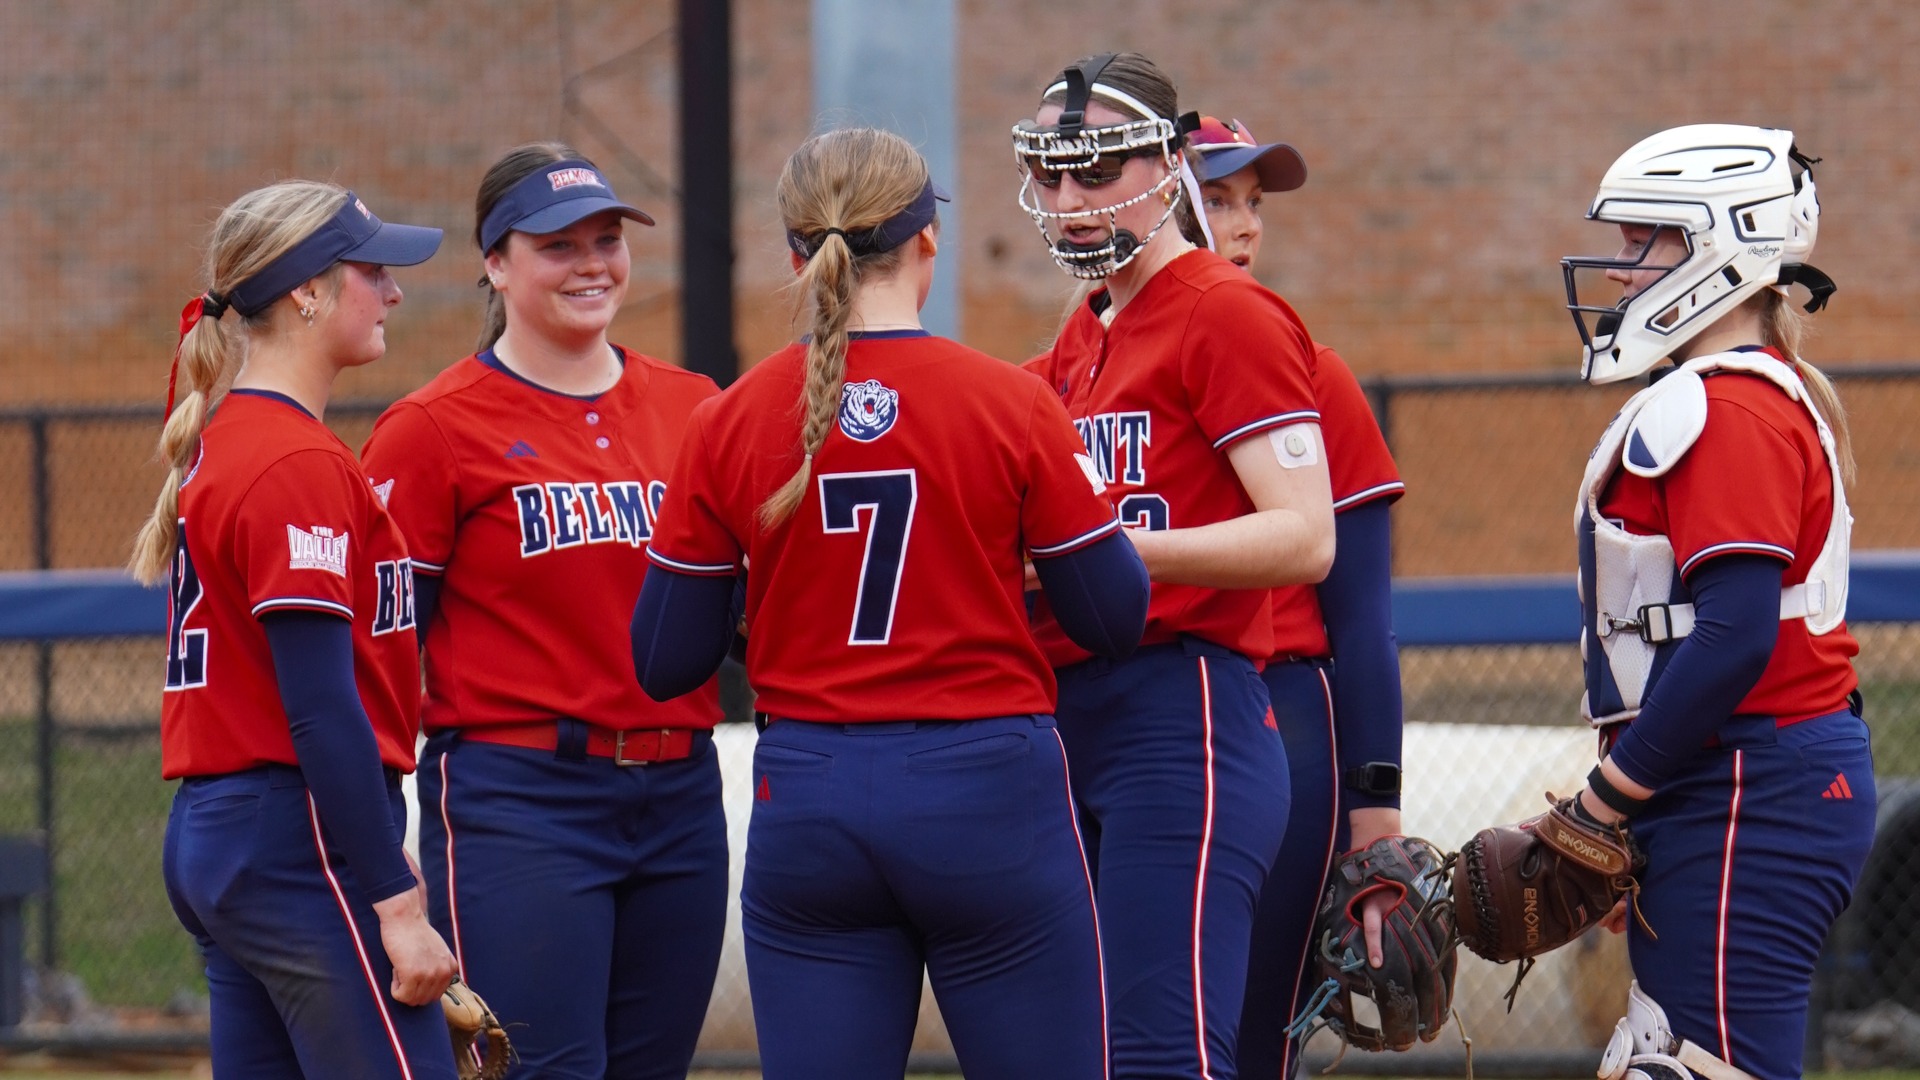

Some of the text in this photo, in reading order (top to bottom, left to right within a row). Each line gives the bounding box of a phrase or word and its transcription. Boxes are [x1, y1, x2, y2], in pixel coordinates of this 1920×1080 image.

[1748, 245, 1780, 258] Rawlings
[1073, 410, 1151, 486] ONT
[286, 524, 349, 567] VALLEY
[818, 468, 917, 646] 7
